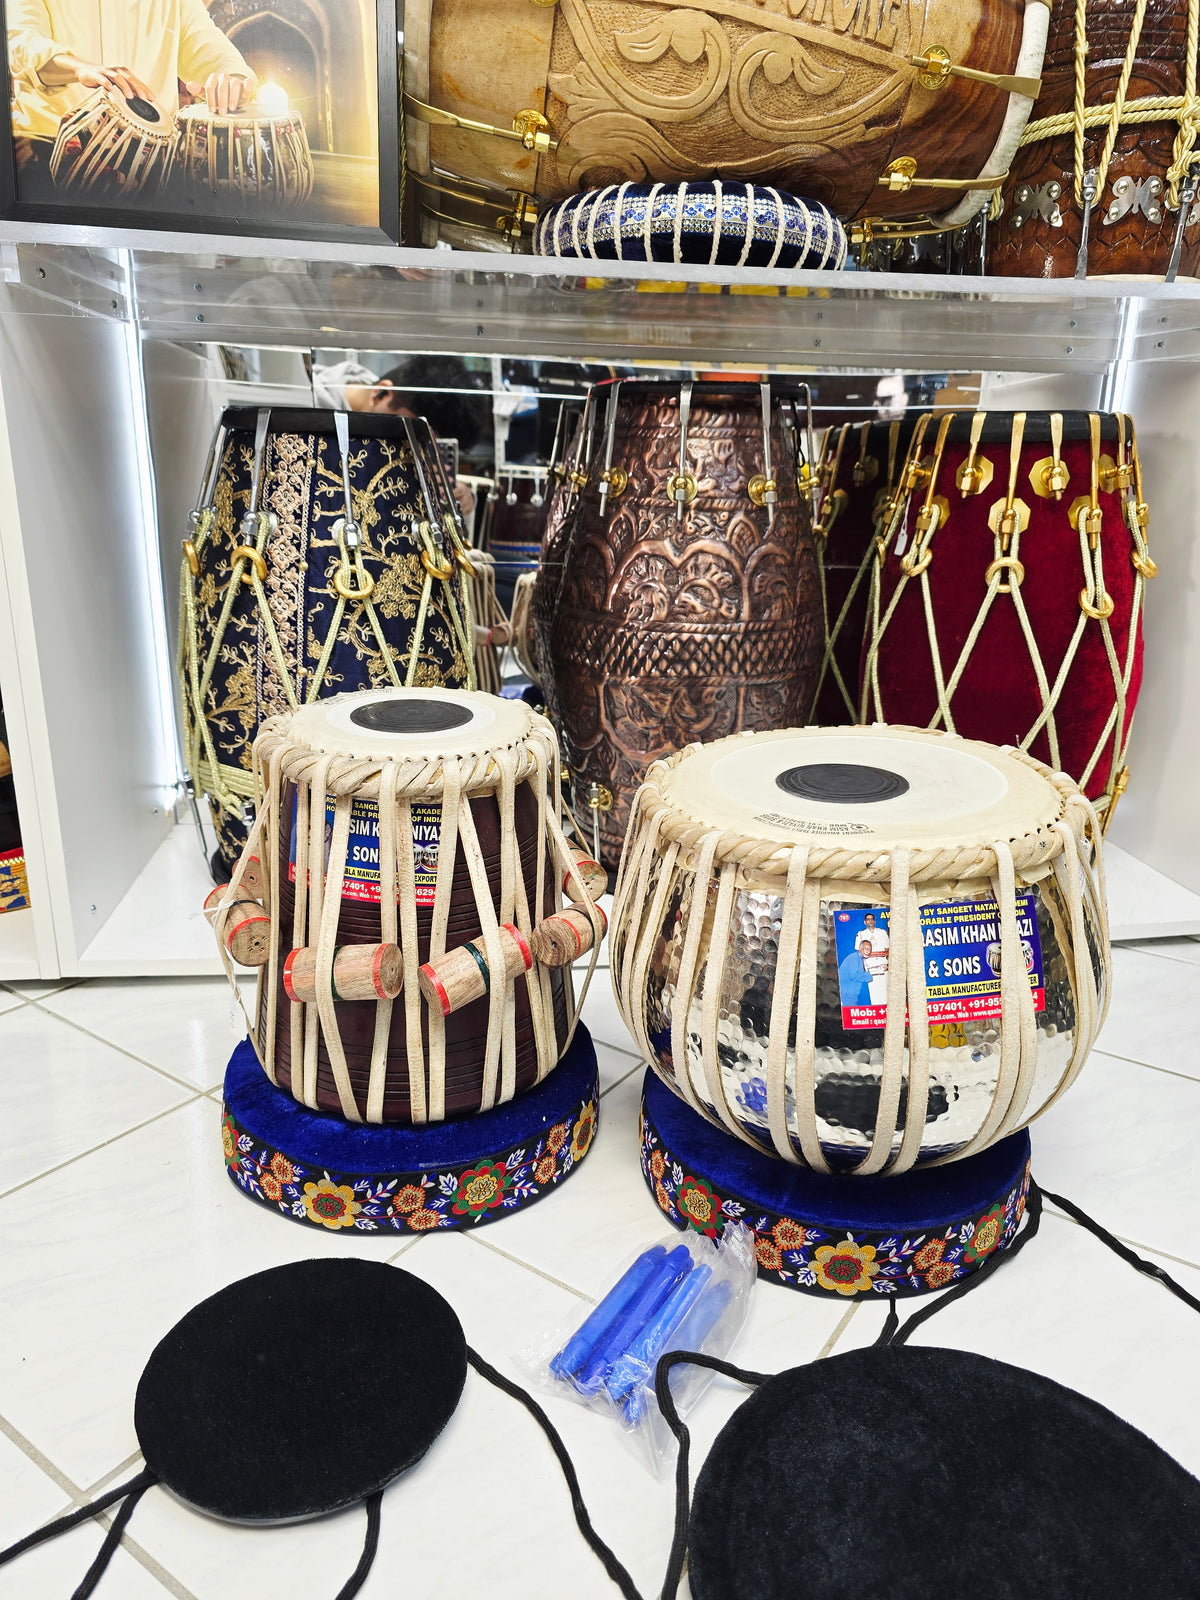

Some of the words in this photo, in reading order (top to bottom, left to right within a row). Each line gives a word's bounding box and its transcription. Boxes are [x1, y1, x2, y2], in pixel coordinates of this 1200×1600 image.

[354, 802, 379, 811] SANGE
[350, 819, 370, 836] SIM
[412, 825, 441, 841] NIYA
[353, 845, 380, 863] SON
[414, 875, 437, 883] EXPORT
[923, 908, 935, 916] BY
[936, 905, 973, 915] SANGEET
[974, 902, 999, 912] NATAK
[953, 912, 996, 923] PRESIDENT
[921, 926, 960, 948] ASIM
[960, 922, 997, 944] KHAN
[928, 959, 940, 979] &
[943, 955, 981, 977] SONS
[928, 986, 951, 997] TABLA
[850, 1008, 876, 1017] Mob:
[851, 1018, 869, 1026] Email
[957, 1011, 969, 1019] Web
